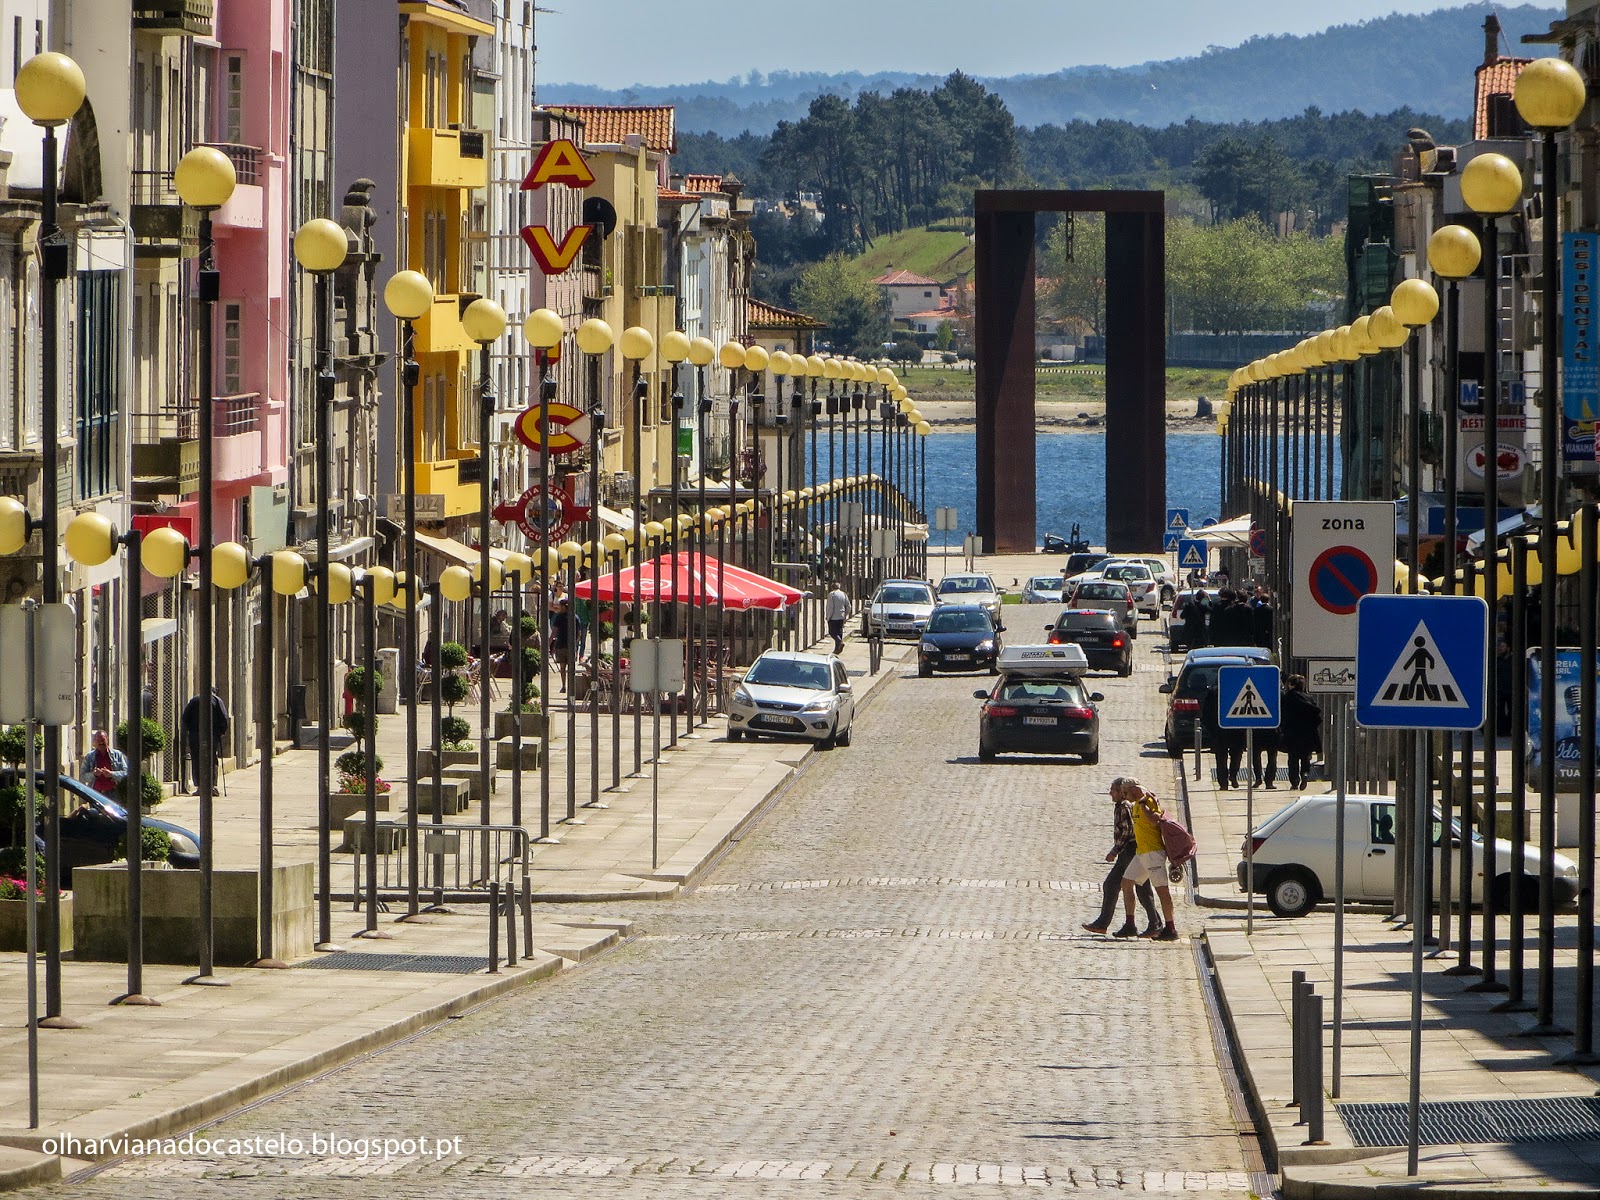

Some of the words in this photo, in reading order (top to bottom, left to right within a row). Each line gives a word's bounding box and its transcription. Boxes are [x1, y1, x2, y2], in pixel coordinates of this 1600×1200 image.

[1574, 240, 1590, 361] RESIDENCIAL
[1462, 418, 1526, 429] RESTRANTE
[1565, 443, 1596, 454] VIANAMA
[522, 485, 568, 501] VIAENS
[1321, 518, 1365, 530] zona
[1559, 768, 1581, 777] TUA
